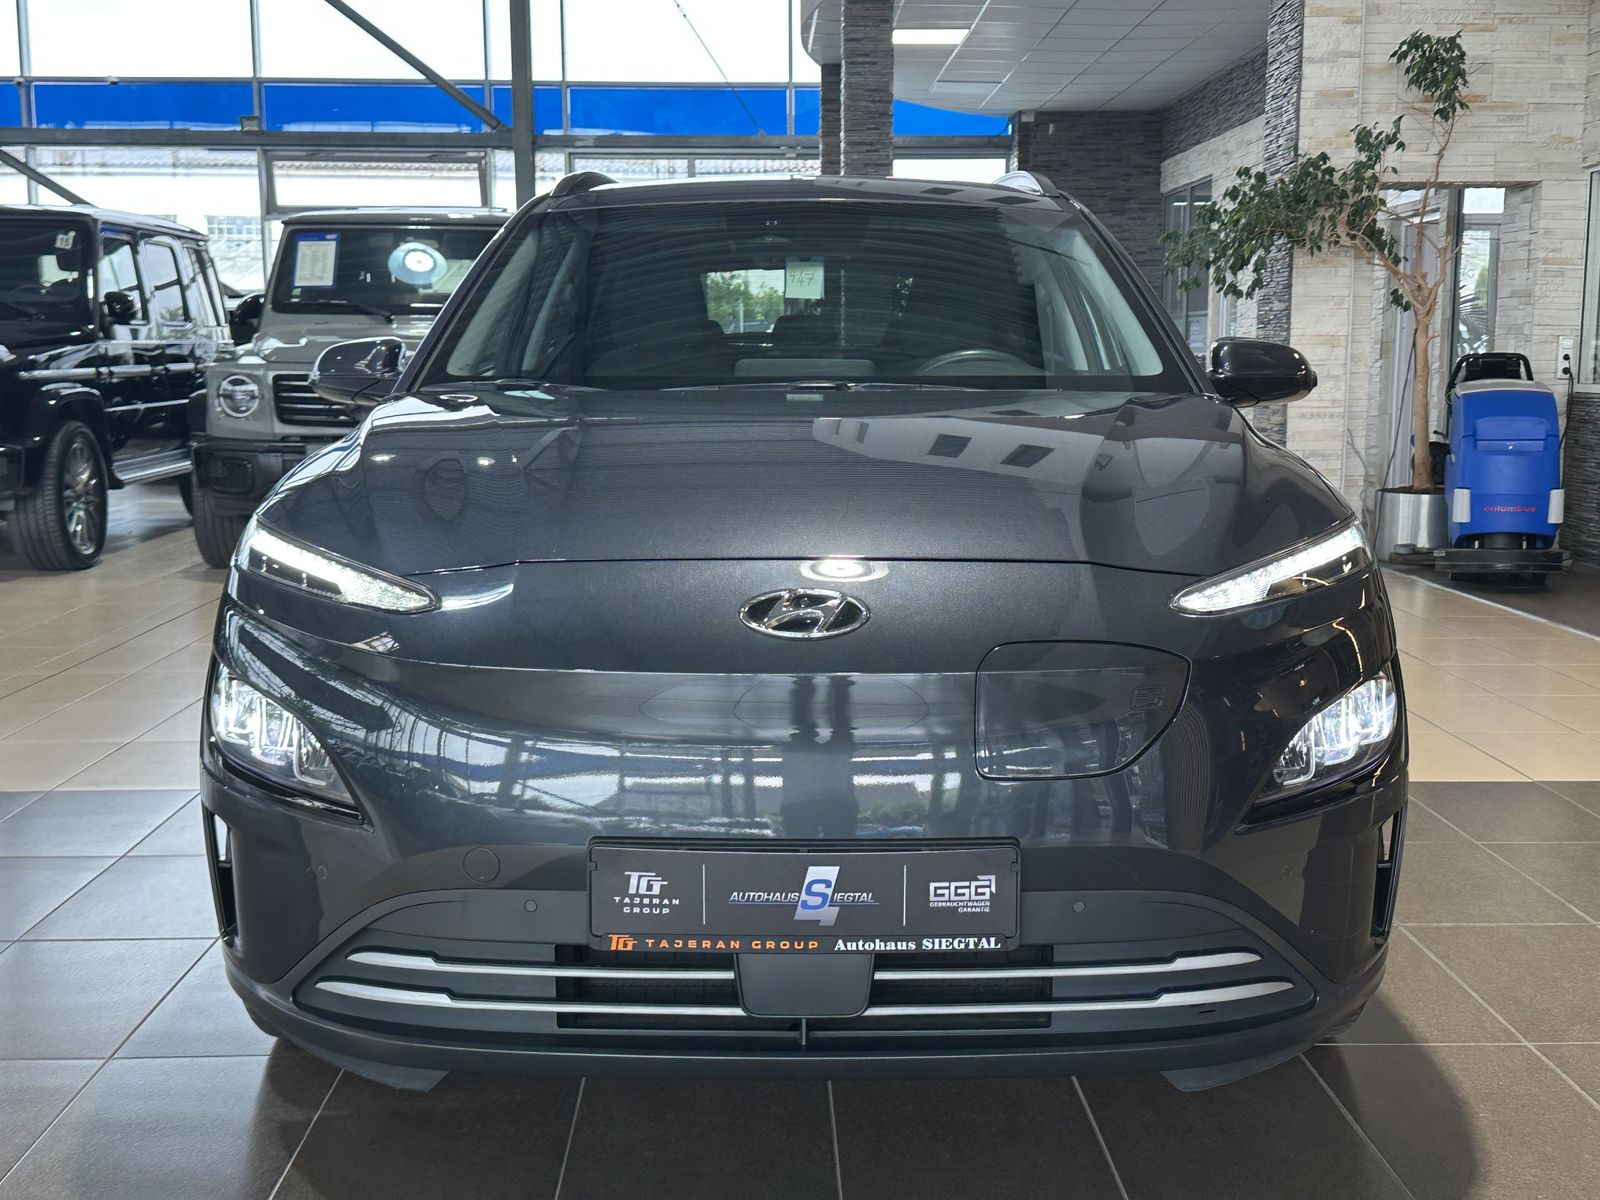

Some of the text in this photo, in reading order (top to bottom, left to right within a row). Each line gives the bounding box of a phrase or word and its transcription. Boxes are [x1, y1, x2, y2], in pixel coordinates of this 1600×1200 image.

[1482, 504, 1537, 512] columbus
[624, 871, 668, 895] TG
[729, 891, 799, 902] AUTOHAUS
[929, 880, 991, 901] GGG
[613, 896, 680, 905] TAJERAN
[623, 906, 670, 914] GROUP
[608, 934, 819, 951] TG TAJERAN GROUP
[834, 937, 1001, 951] Autohaus SIEGTAL
